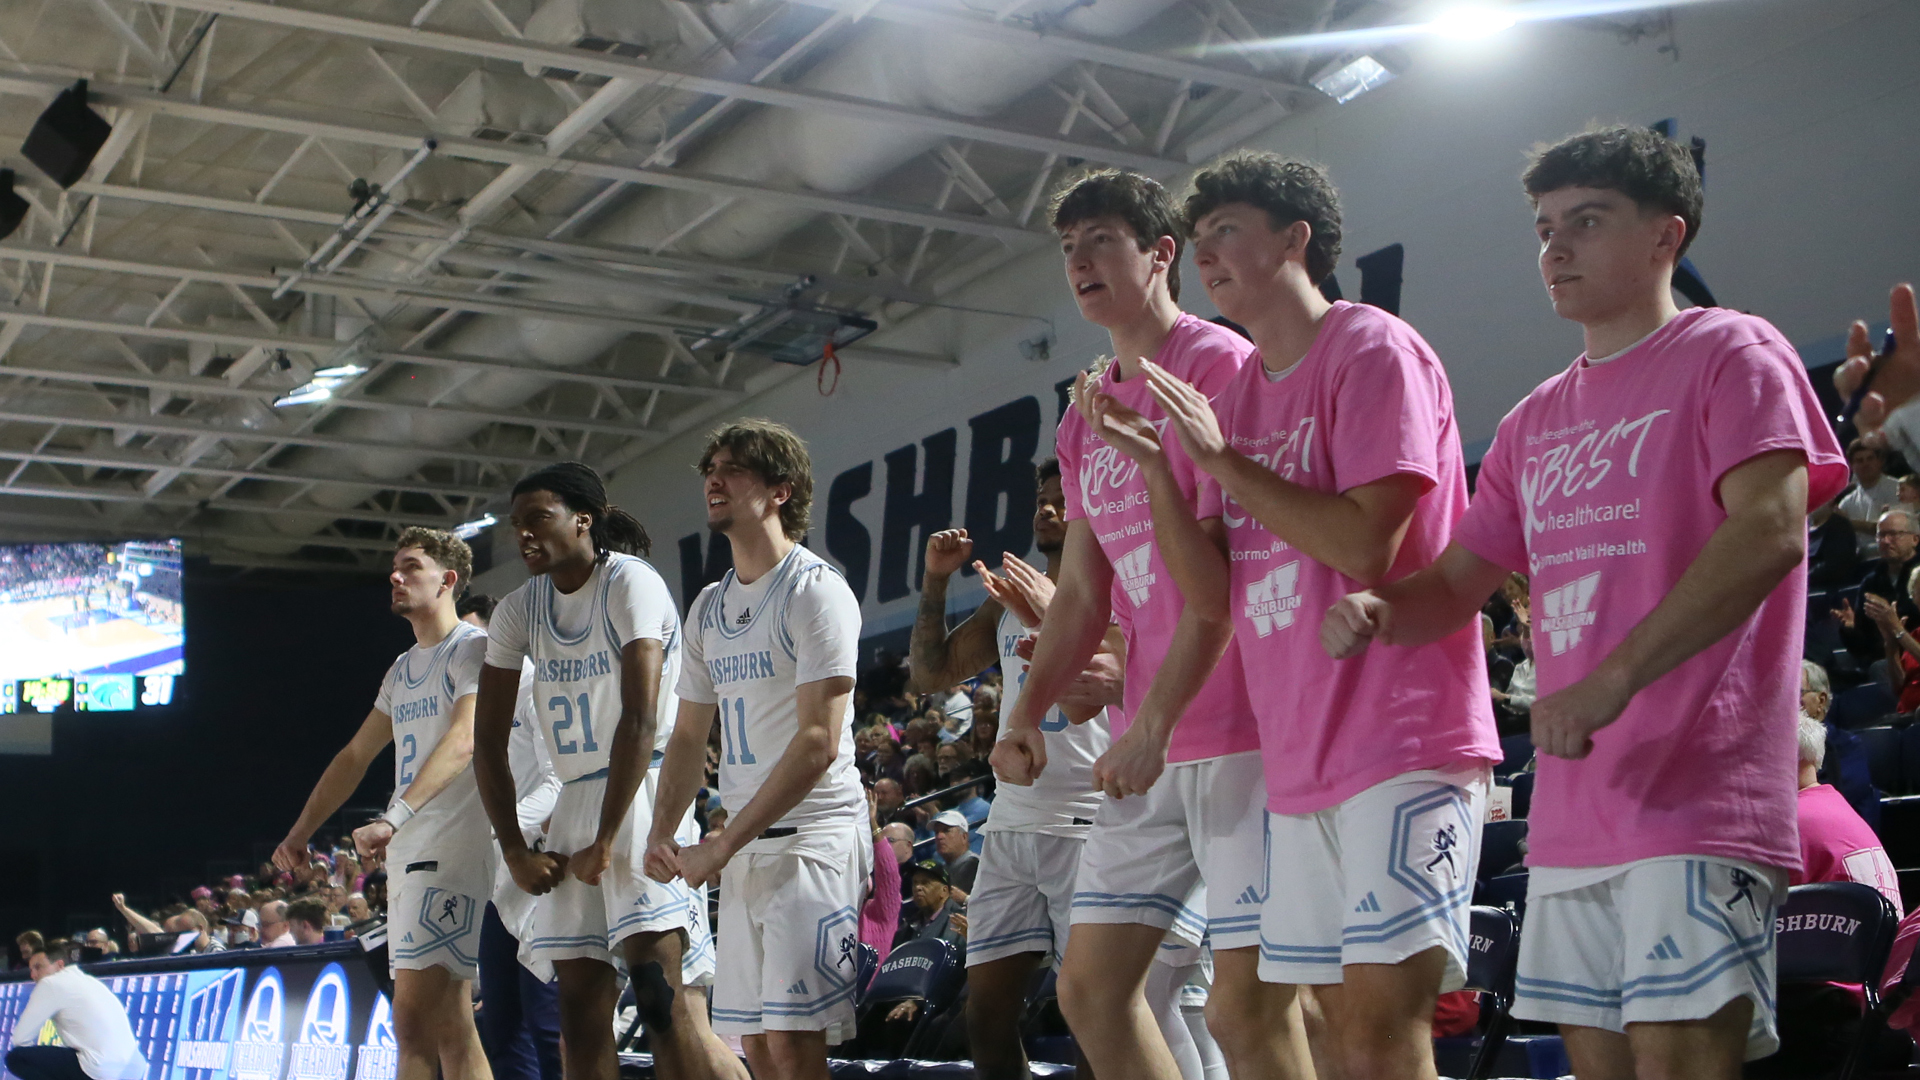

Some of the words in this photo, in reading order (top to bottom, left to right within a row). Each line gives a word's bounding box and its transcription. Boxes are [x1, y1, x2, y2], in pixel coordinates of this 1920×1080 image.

[1536, 409, 1671, 507] BEST
[1102, 490, 1151, 515] healthca
[1547, 498, 1640, 531] healthcare!
[1124, 523, 1142, 537] Vail
[1230, 549, 1270, 561] tormo
[1575, 544, 1596, 560] Vail
[1597, 538, 1647, 557] Health
[707, 650, 775, 686] ASHBURN
[141, 675, 174, 705] 31
[548, 692, 598, 754] 21
[721, 697, 757, 765] 11
[400, 733, 417, 786] 2
[1775, 913, 1861, 937] SHBURN
[881, 956, 934, 974] WASHBURN
[355, 1044, 398, 1080] ICHAB
